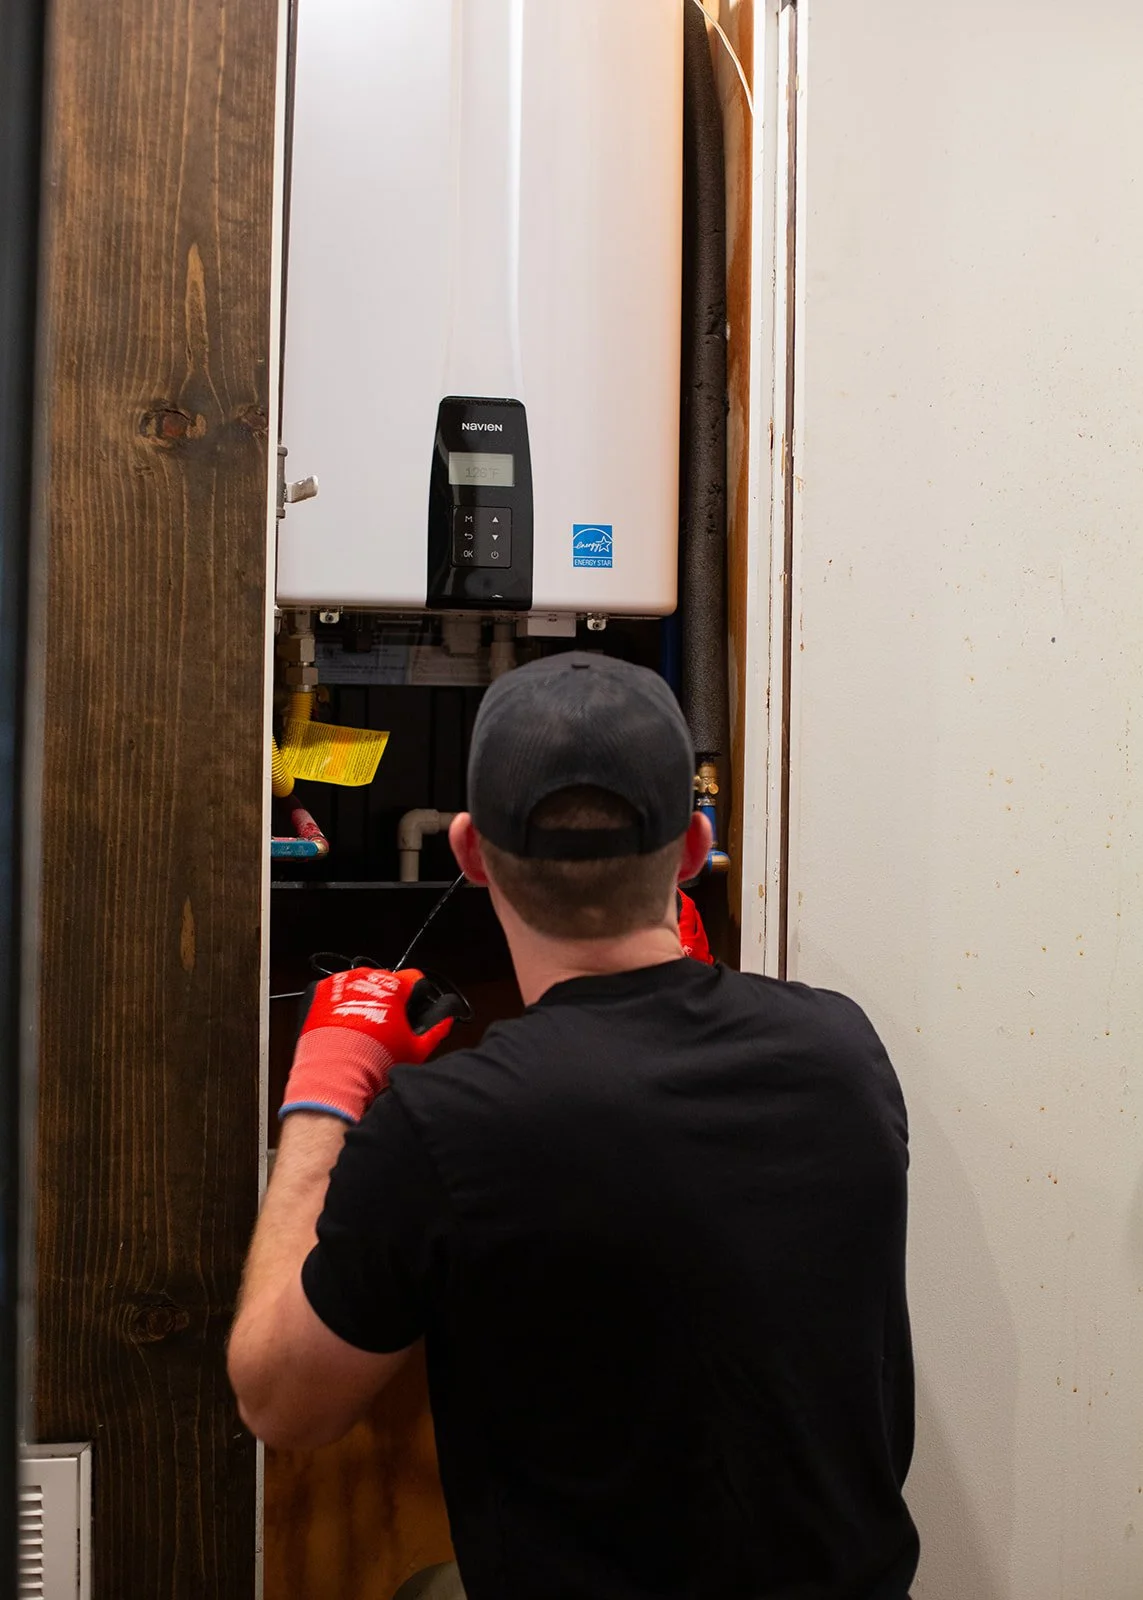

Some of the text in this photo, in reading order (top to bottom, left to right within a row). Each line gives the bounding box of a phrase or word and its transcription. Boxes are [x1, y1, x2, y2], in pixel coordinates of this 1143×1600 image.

[464, 515, 473, 523] M
[463, 550, 474, 558] OK
[574, 558, 612, 567] ENERGY STAR
